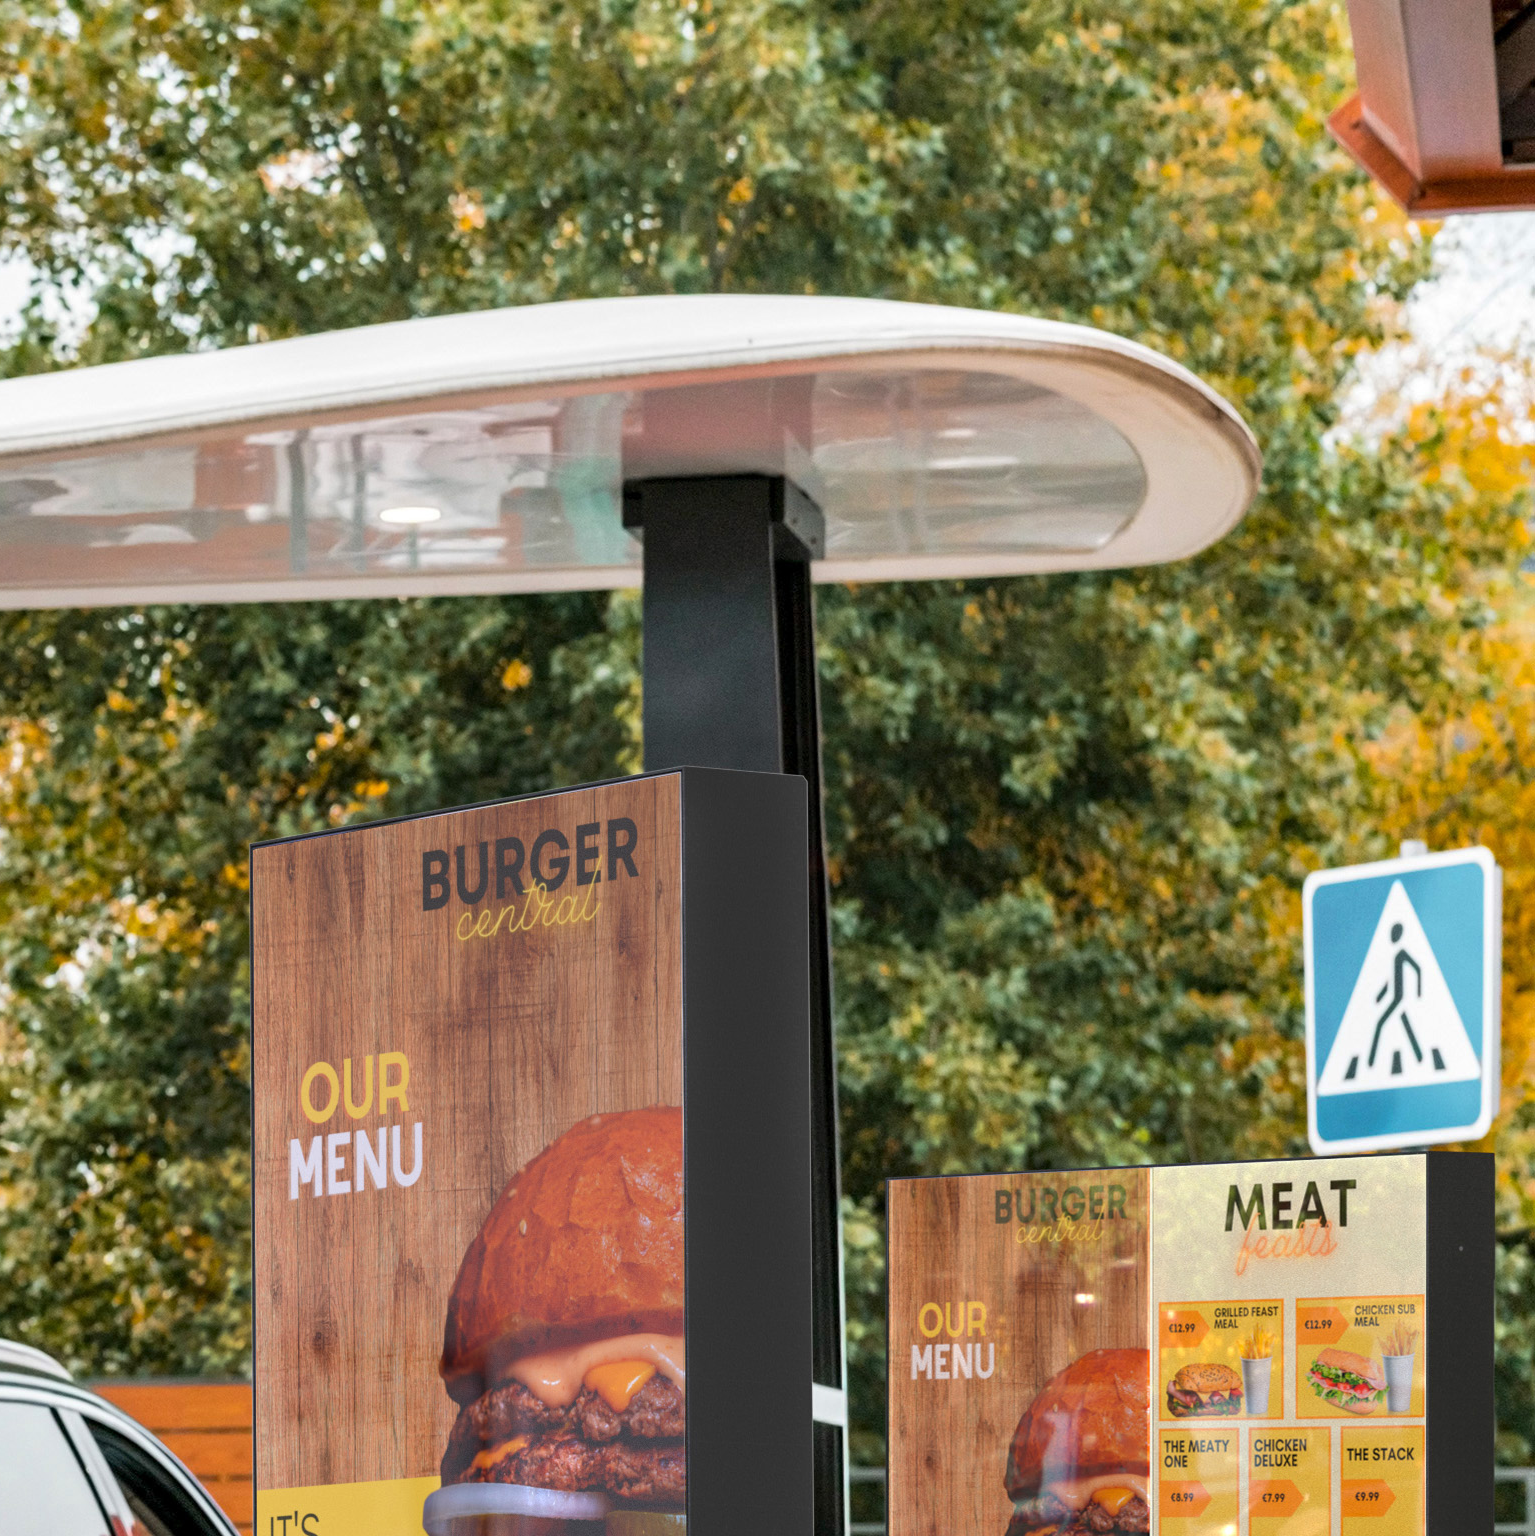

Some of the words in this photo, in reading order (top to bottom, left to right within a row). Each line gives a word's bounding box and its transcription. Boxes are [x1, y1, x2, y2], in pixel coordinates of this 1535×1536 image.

[422, 816, 639, 911] BURGER
[456, 854, 602, 940] central
[300, 1051, 410, 1123] OUR
[289, 1122, 424, 1200] MENU
[994, 1184, 1127, 1224] BURGER
[1224, 1179, 1357, 1232] MEAT
[1016, 1202, 1105, 1243] central
[1235, 1212, 1338, 1276] feasts
[1214, 1307, 1250, 1318] GRILLED
[1251, 1306, 1279, 1317] FEAST
[1354, 1304, 1395, 1316] CHICKEN
[1397, 1304, 1416, 1315] SUB
[918, 1301, 987, 1338] OUR
[1214, 1318, 1239, 1329] MEAL
[1304, 1319, 1332, 1330] €12.99
[1354, 1316, 1380, 1327] MEAL
[1168, 1323, 1196, 1333] €12.99
[910, 1342, 995, 1380] MENU
[1164, 1440, 1185, 1453] THE
[1188, 1439, 1229, 1453] MEATY
[1254, 1439, 1307, 1452] CHICKEN
[1254, 1454, 1298, 1467] DELUXE
[1347, 1448, 1369, 1461] THE
[1372, 1447, 1415, 1461] STACK
[1164, 1455, 1188, 1468] ONE
[1170, 1492, 1194, 1503] €8.99
[1262, 1493, 1285, 1503] €7.99
[1354, 1492, 1379, 1502] €9.99
